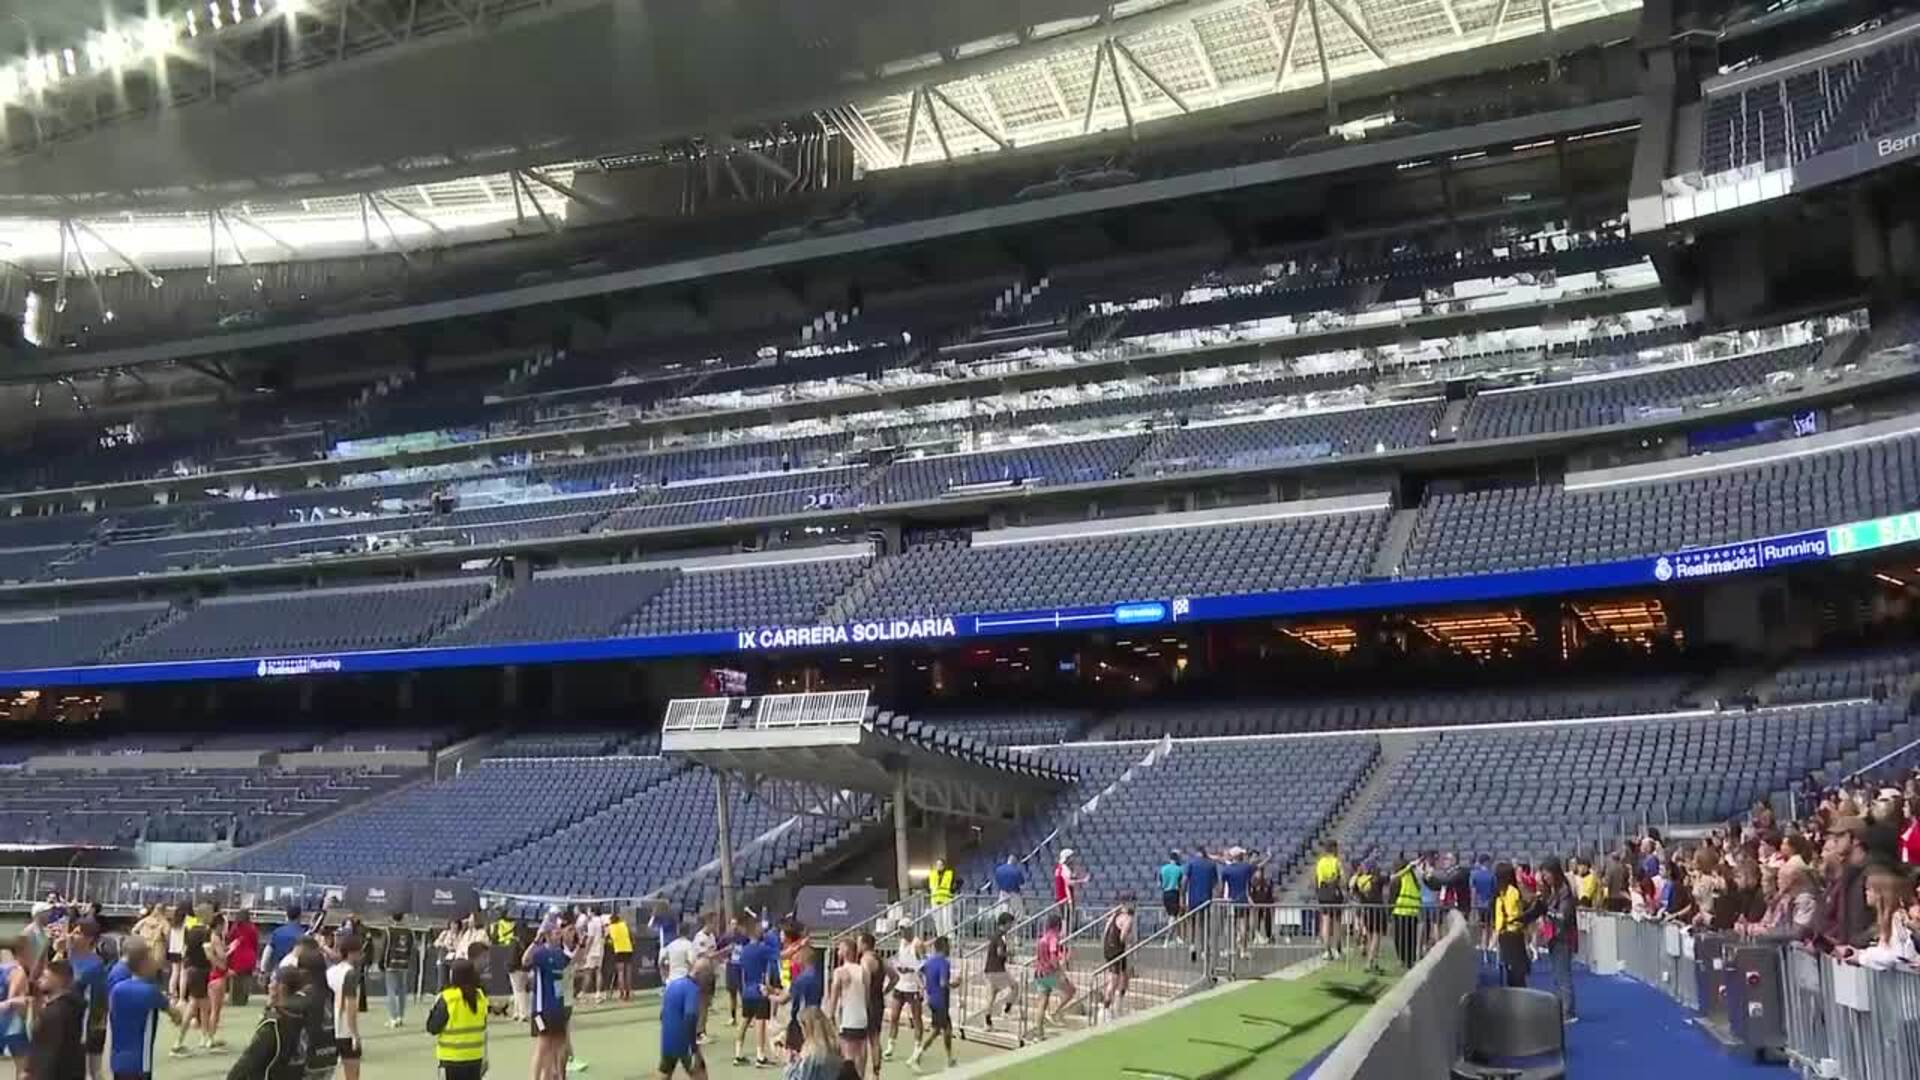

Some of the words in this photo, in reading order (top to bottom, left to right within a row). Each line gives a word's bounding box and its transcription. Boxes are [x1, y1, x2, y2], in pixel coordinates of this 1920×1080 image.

[1765, 540, 1825, 561] Running
[1677, 555, 1758, 578] Realmadrid
[738, 631, 756, 649] IX
[759, 625, 848, 648] CARRERA
[852, 618, 956, 641] SOLIDARIA
